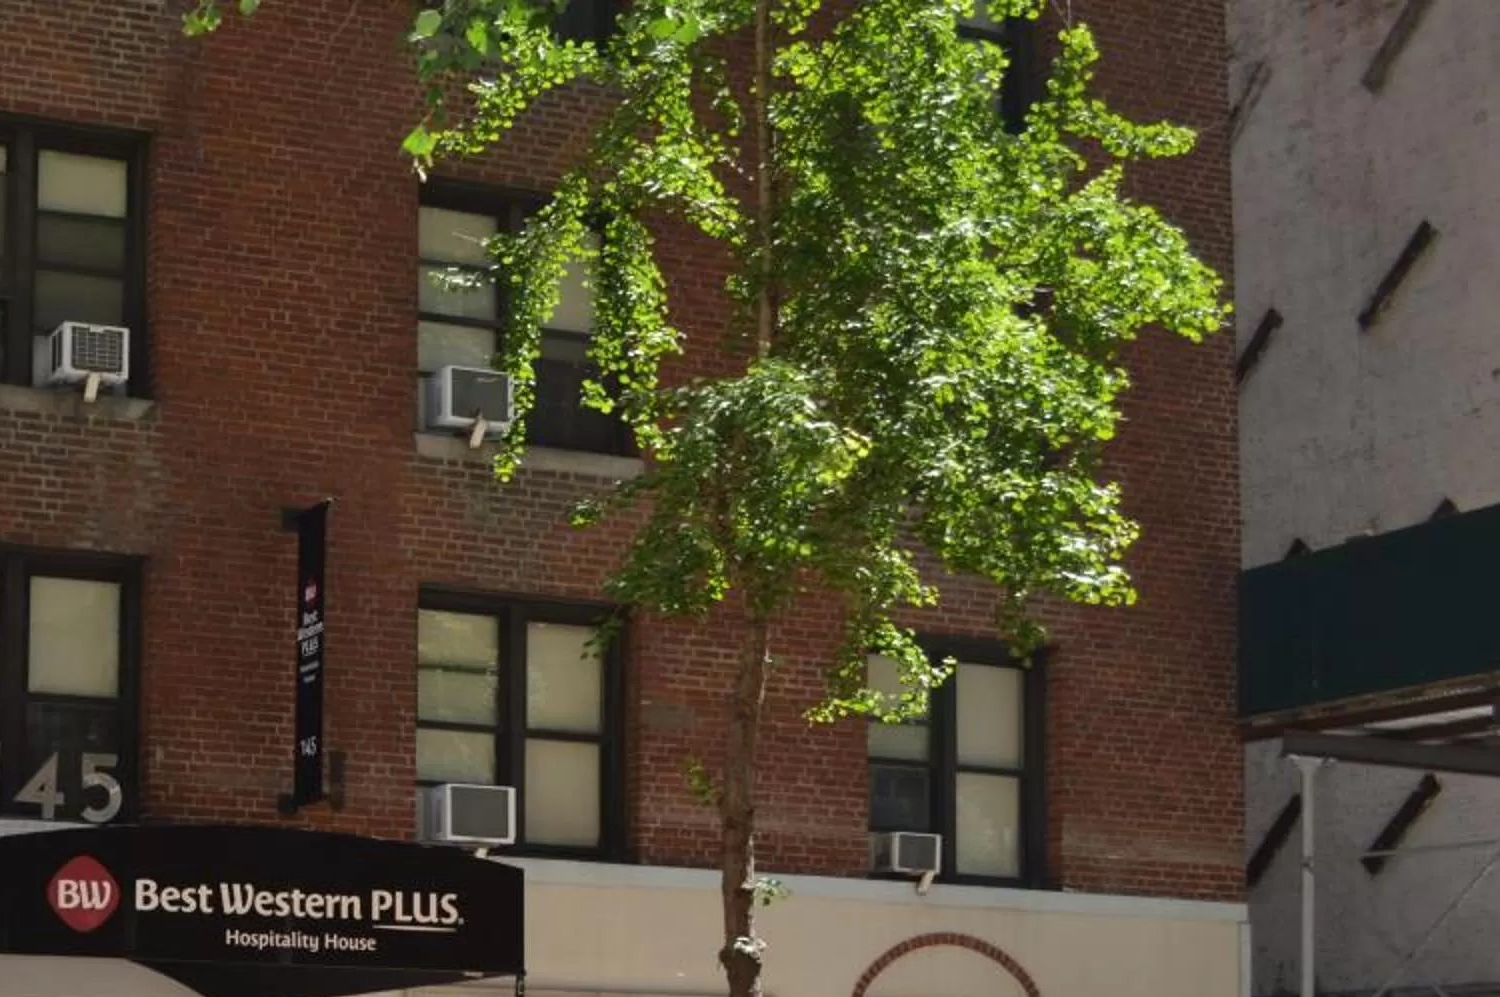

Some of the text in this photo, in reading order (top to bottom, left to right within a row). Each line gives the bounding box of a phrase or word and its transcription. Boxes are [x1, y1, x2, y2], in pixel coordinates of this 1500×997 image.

[57, 879, 112, 911] BW
[134, 878, 213, 913] Best
[221, 882, 362, 921] Western
[225, 929, 377, 953] Hospitality House
